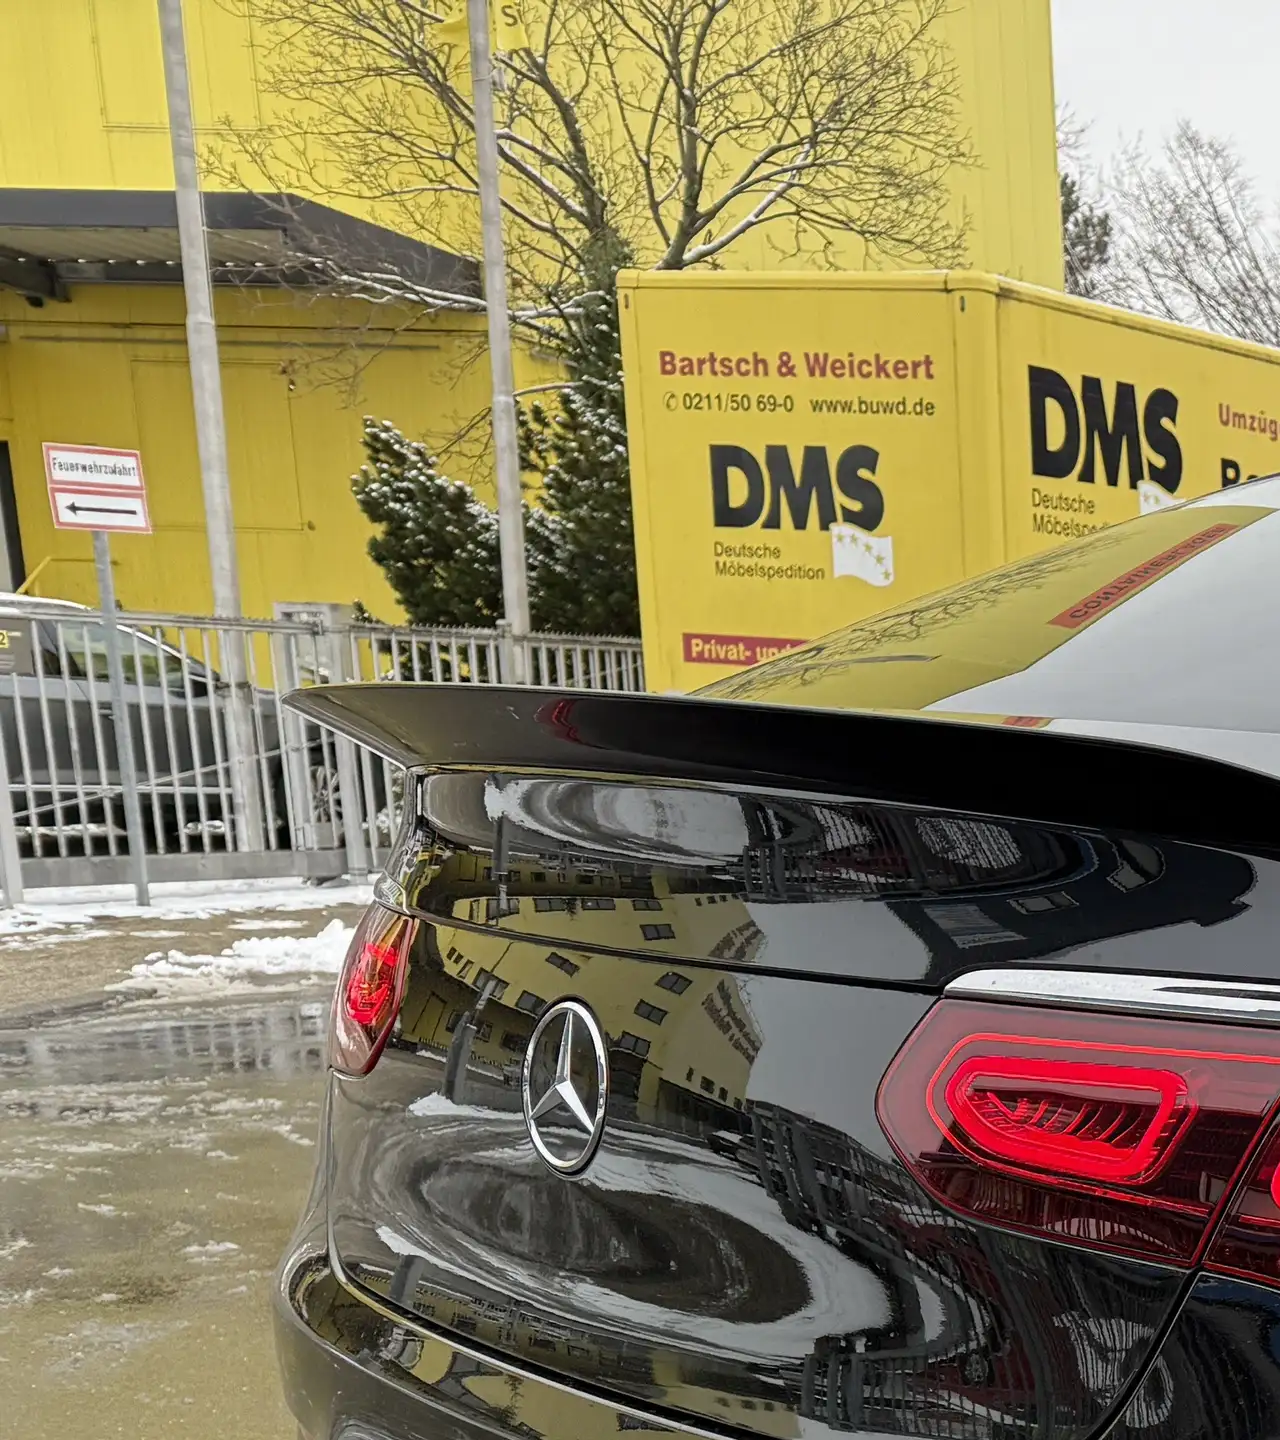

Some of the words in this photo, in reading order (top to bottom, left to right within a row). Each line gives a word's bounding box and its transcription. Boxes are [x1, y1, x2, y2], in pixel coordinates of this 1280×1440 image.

[659, 351, 769, 377] Bartsch
[777, 351, 797, 377] &
[804, 352, 934, 379] Weickert
[682, 392, 751, 412] 0211/50
[756, 394, 794, 413] 69-0
[810, 397, 936, 416] www.buwd.de
[1028, 364, 1183, 494] DMS
[52, 457, 136, 477] Feuerwehrzufahrt
[709, 444, 884, 532] DMS
[1032, 488, 1095, 514] Deutsche
[714, 541, 781, 560] Deutsche
[715, 562, 825, 581] Möbelspedition
[691, 638, 750, 661] Privat-
